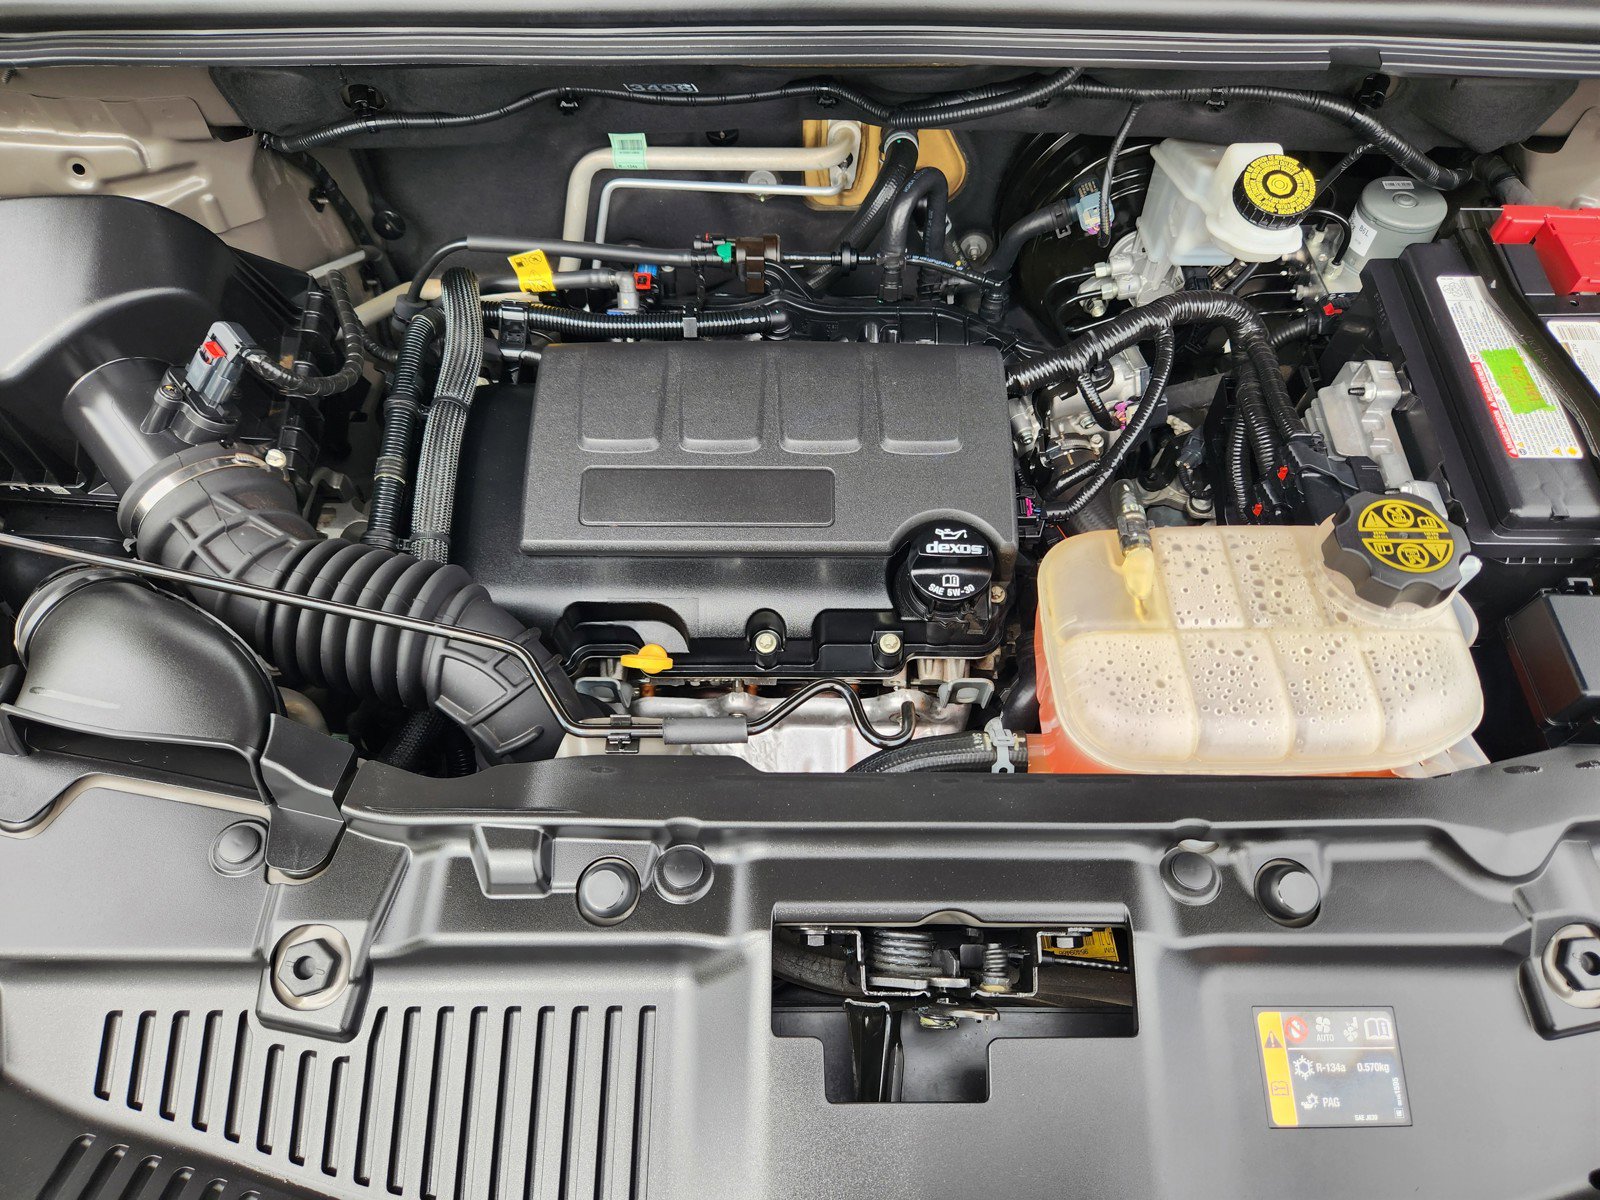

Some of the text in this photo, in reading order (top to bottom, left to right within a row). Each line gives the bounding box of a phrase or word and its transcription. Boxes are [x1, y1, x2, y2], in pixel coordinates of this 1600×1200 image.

[925, 541, 984, 554] dexos
[928, 583, 976, 597] SAE 5W-30
[1316, 1034, 1335, 1042] AUTO
[1316, 1062, 1390, 1073] R-134a 0.570kg
[1322, 1097, 1340, 1107] PAG
